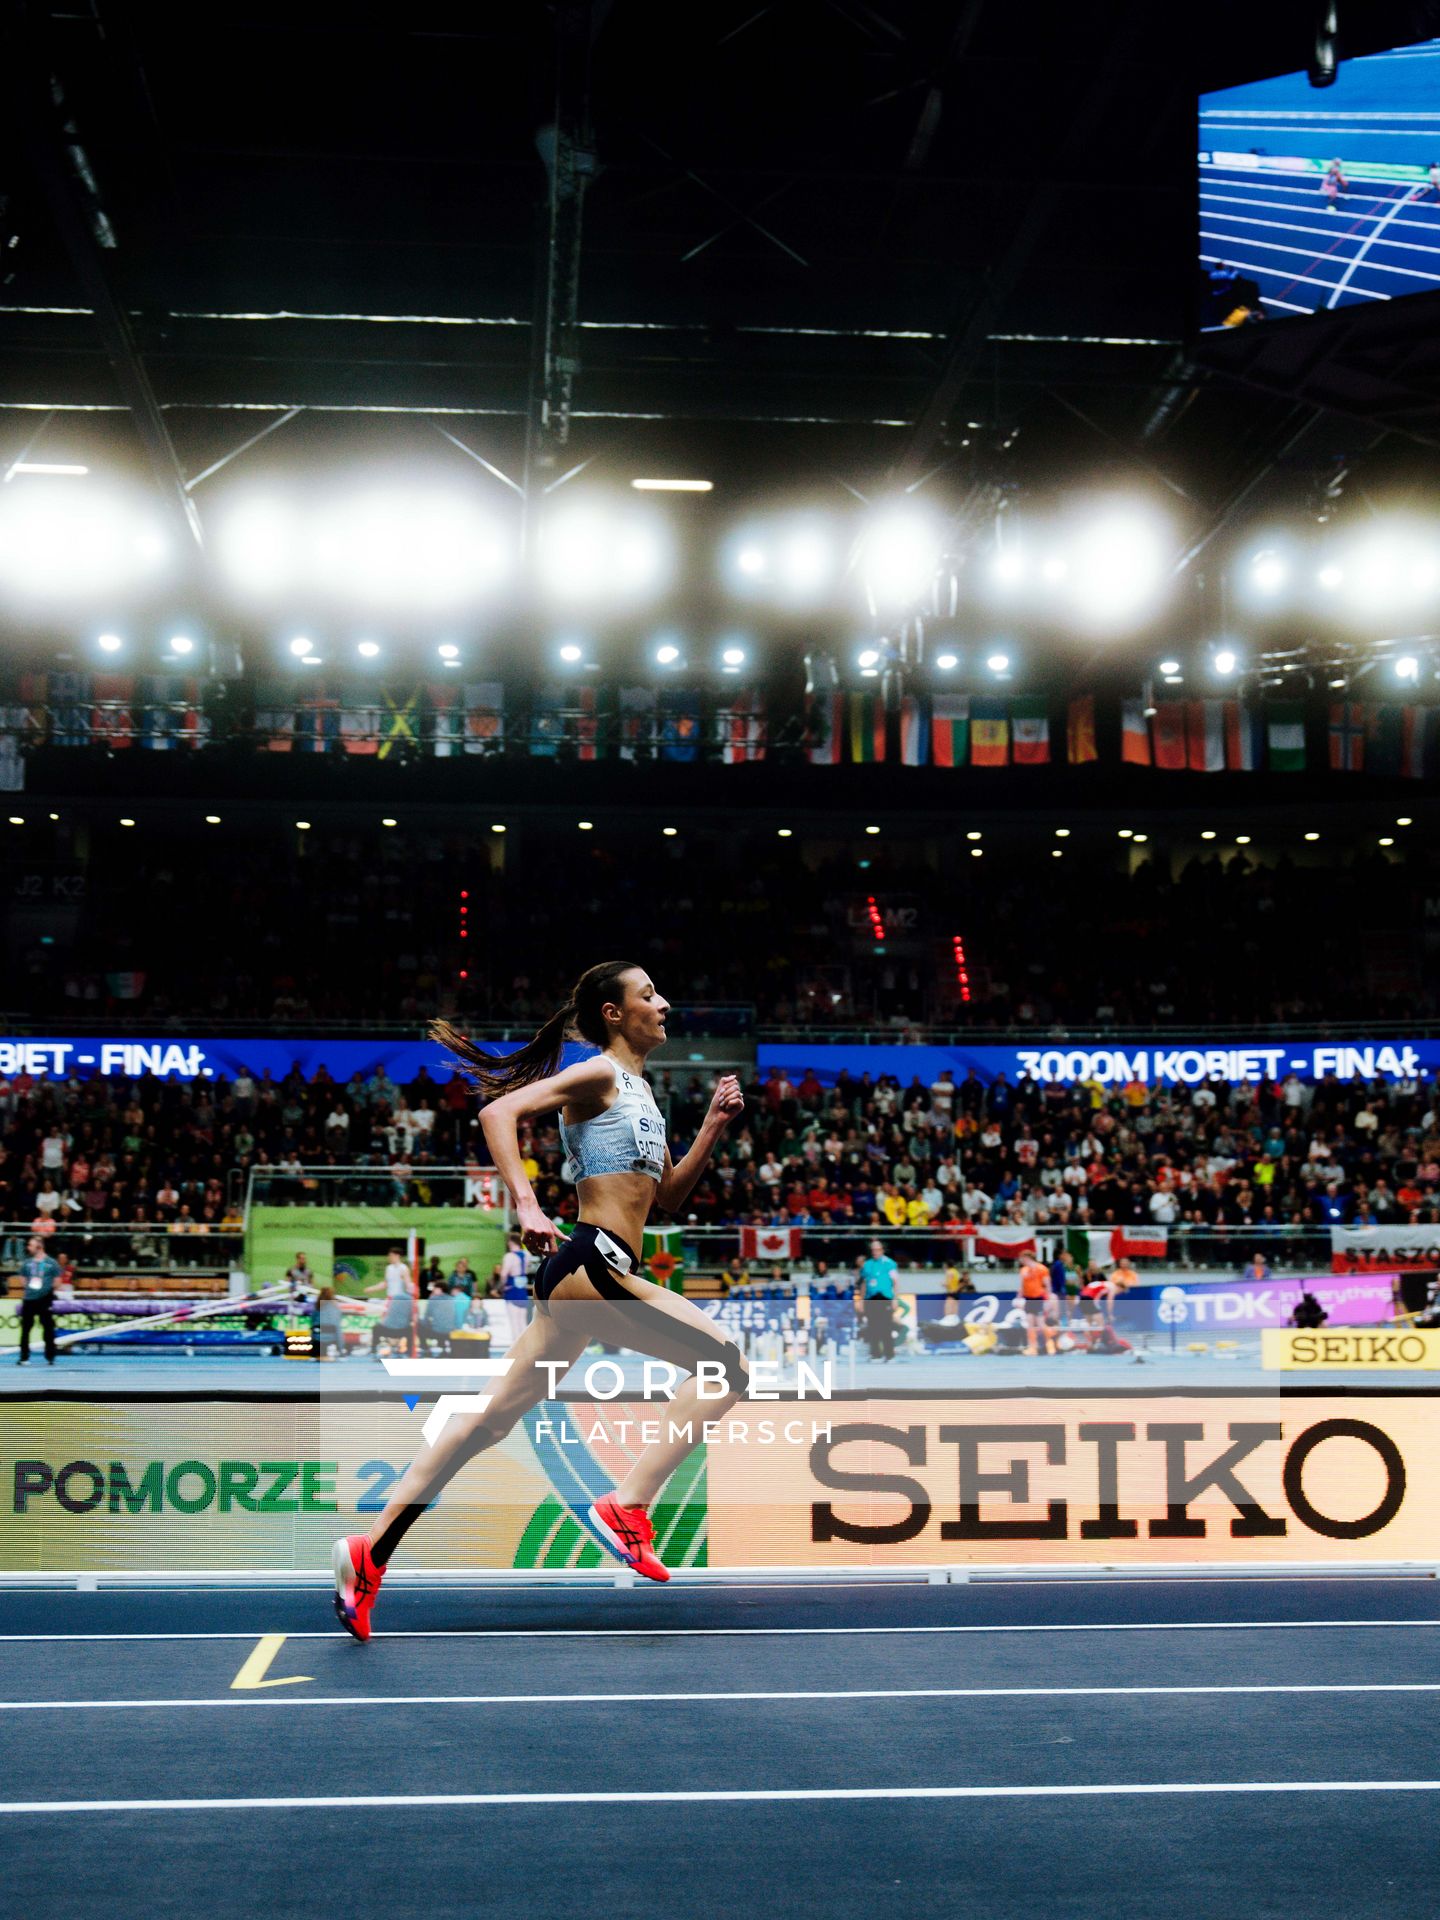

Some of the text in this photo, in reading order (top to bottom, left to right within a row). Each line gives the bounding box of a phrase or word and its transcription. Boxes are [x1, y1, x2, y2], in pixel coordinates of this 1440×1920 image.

[77, 1055, 95, 1064] -
[1016, 1050, 1149, 1082] 3000M
[1153, 1049, 1286, 1082] KOBIET
[1290, 1060, 1308, 1069] -
[1186, 1290, 1276, 1321] TDK
[1291, 1336, 1426, 1363] SEIKO
[13, 1460, 338, 1513] POMORZE
[809, 1418, 1407, 1544] SEIKO
